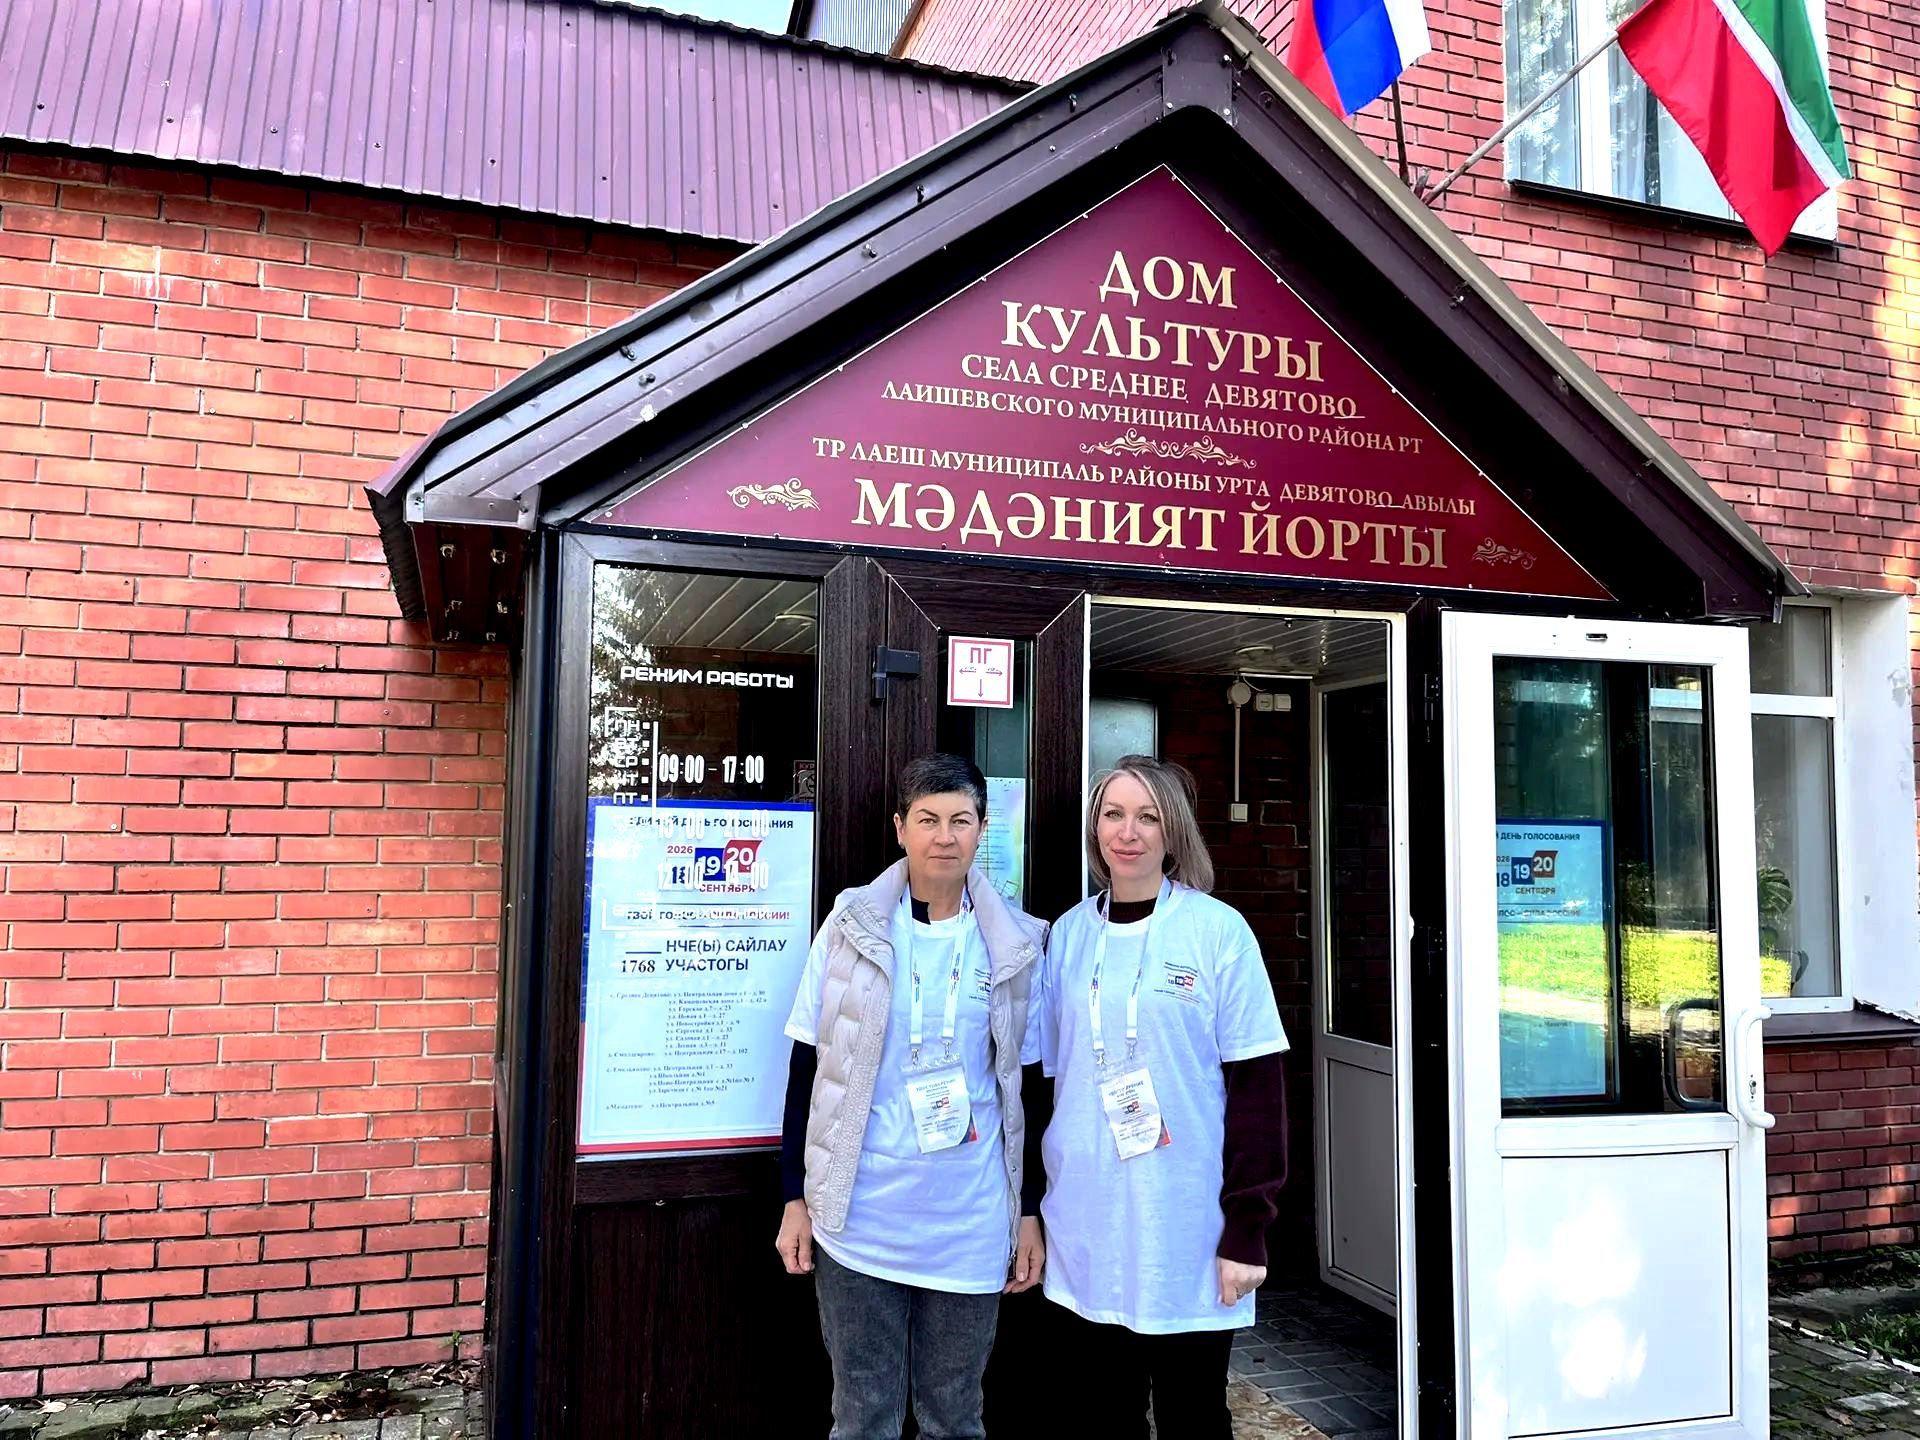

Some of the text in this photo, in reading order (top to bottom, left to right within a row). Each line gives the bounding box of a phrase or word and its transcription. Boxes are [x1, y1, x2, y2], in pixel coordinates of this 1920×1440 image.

[1099, 250, 1238, 310] ДОМ
[1001, 299, 1325, 383] КУЛЬТУРЫ
[961, 353, 1359, 418] СЕЛА СРЕДНЕЕ ДЕВЯТОВО
[881, 381, 1423, 454] ЛАИШЕВСКОГО МУНИЦИПАЛЬНОГО РАЙОНА РТ
[812, 436, 1477, 516] ТР ЛАЕШ МУНИЦИПАЛЬ РАЙОНЫ УРТА ДЕВЯТОВО АВЫЛЫ
[850, 477, 1448, 569] МӘДӘНИЯТ ЙОРТЫ
[970, 646, 992, 665] ПГ
[620, 665, 794, 689] РЕЖИМ РАБОТЫ
[614, 719, 640, 733] ПН
[614, 755, 639, 768] СР
[659, 753, 705, 784] 09:00
[722, 755, 764, 784] 17:00
[613, 792, 638, 805] ПТ
[1500, 832, 1581, 841] ДЕНЬ ГОЛОСОВАНИЯ
[667, 845, 694, 854] 2026
[696, 855, 722, 878] 19
[725, 847, 754, 865] 20
[1513, 863, 1531, 880] 19
[1533, 856, 1553, 873] 20
[700, 883, 756, 894] СЕНТЯБРЯ
[1515, 887, 1556, 895] СЕНТЯБРЯ
[666, 937, 788, 955] НЧЕ(Ы) САЙЛАУ
[620, 957, 749, 974] 1768 УЧАСТОГЫ
